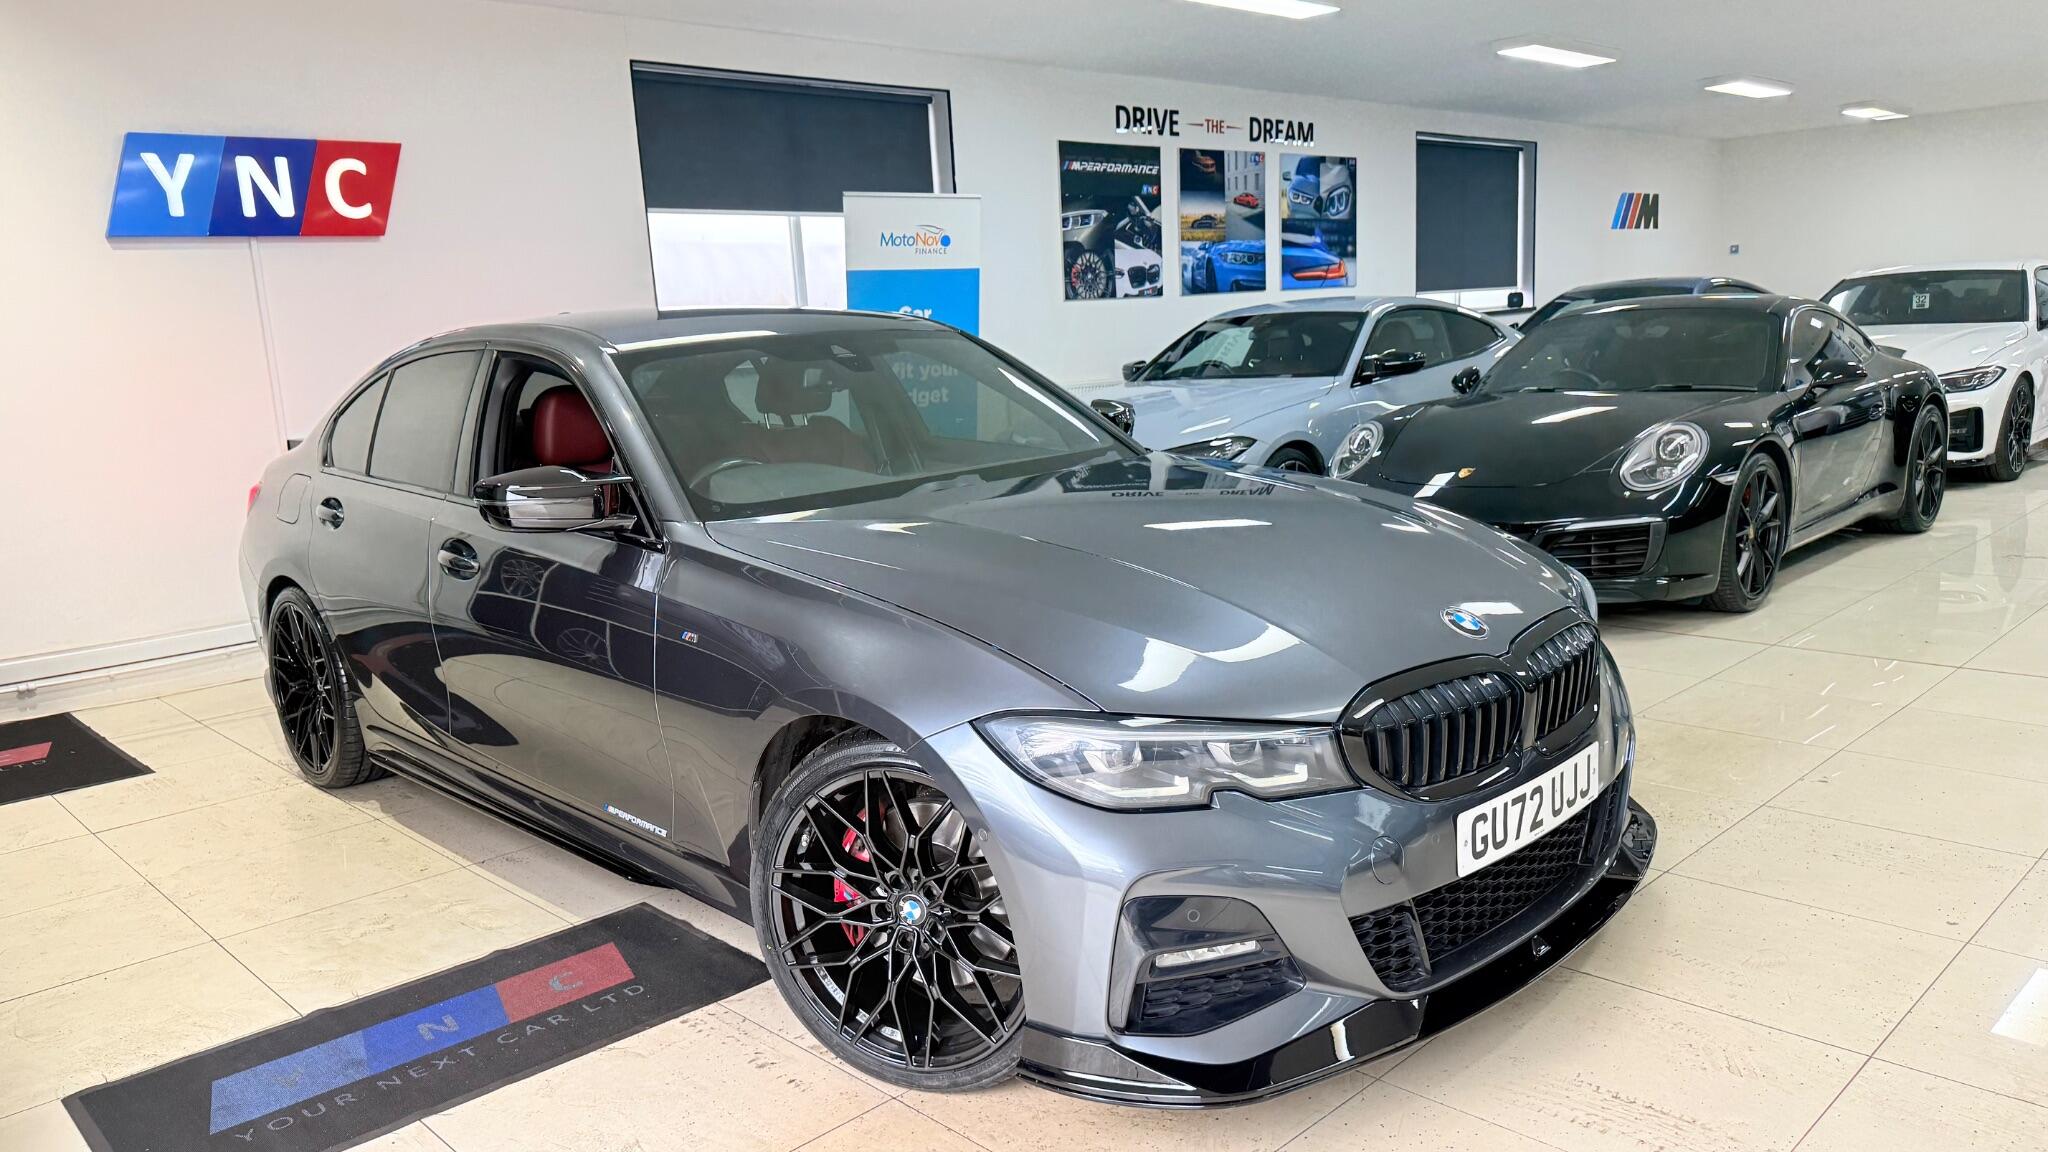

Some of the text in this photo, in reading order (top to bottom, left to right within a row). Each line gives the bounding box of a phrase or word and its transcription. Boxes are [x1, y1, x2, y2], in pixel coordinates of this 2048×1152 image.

[1115, 104, 1315, 147] DRIVE THE DREAM
[140, 152, 373, 219] YNC
[915, 247, 948, 255] FINANCE
[1915, 295, 1927, 304] 32
[1471, 754, 1591, 860] GU72 UJJ
[235, 984, 645, 1143] YOUR NEXT CAR LTD
